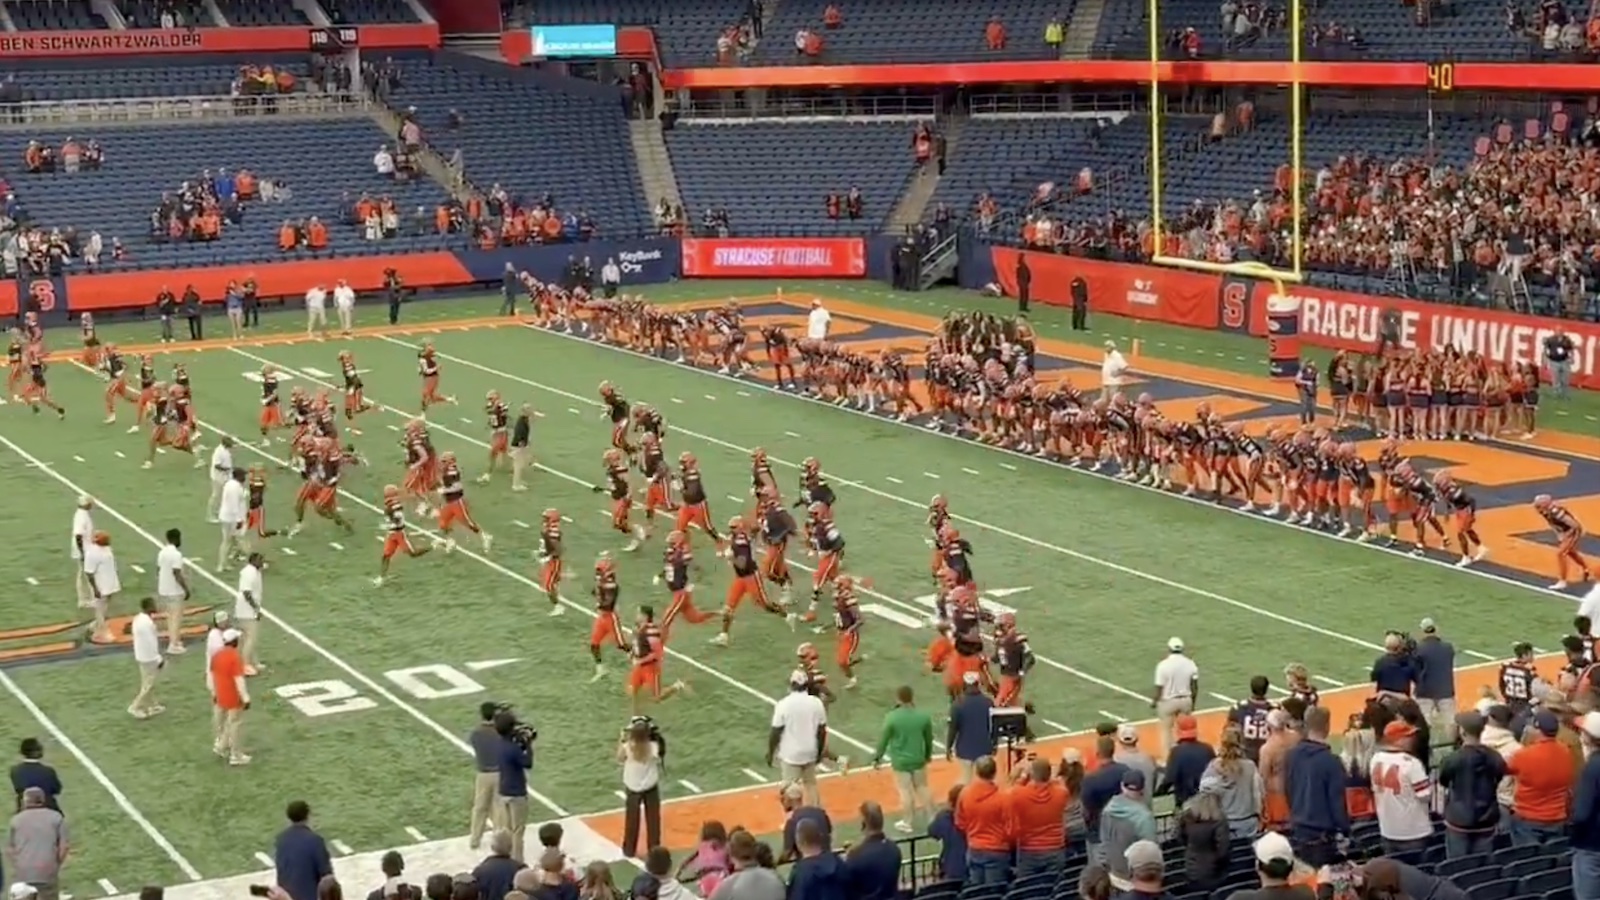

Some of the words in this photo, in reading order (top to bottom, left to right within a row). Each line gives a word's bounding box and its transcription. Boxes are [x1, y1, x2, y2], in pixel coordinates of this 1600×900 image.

[0, 37, 34, 51] BEN
[40, 33, 201, 50] SCHWARTZWALDER
[1428, 63, 1452, 89] 40
[619, 250, 662, 262] KeyBank
[714, 247, 774, 265] SYRACUSE
[776, 247, 832, 265] FOOTBALL
[1223, 282, 1247, 328] S
[1503, 675, 1528, 699] 32
[1372, 762, 1402, 796] 44
